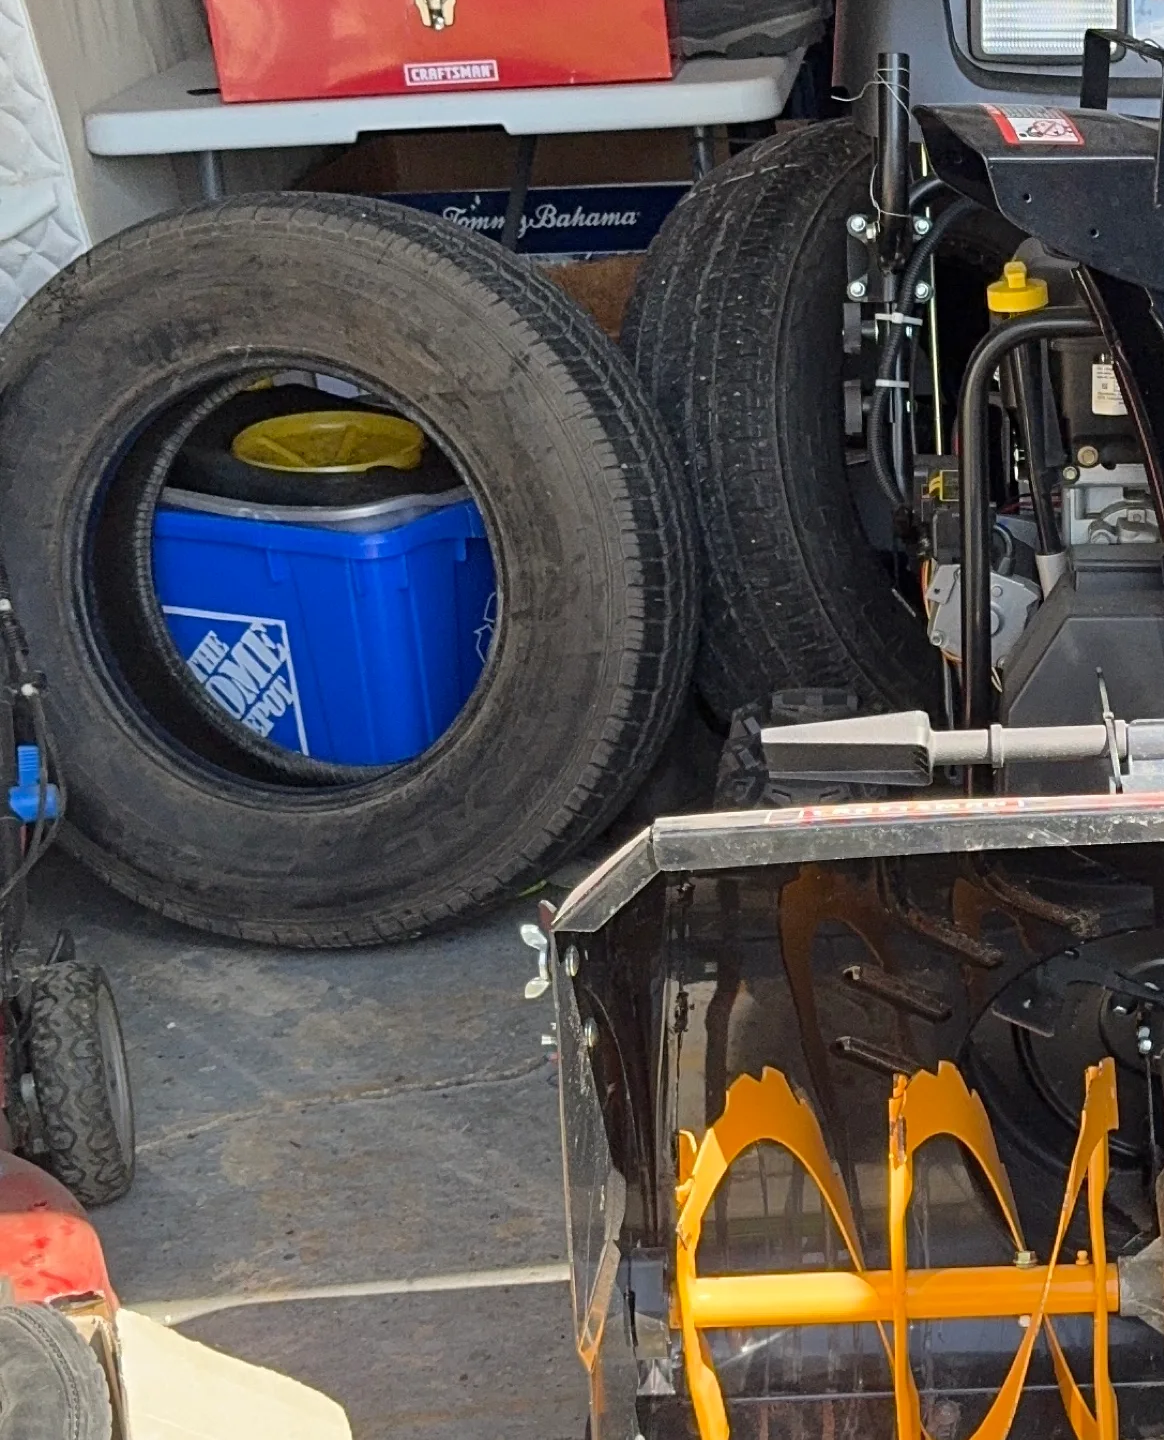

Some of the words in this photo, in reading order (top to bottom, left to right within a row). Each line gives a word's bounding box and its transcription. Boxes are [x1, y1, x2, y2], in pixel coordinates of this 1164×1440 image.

[410, 64, 493, 82] CRAFTSMAN
[534, 203, 639, 230] Bahama
[186, 629, 230, 685] THE
[204, 621, 288, 721] OME
